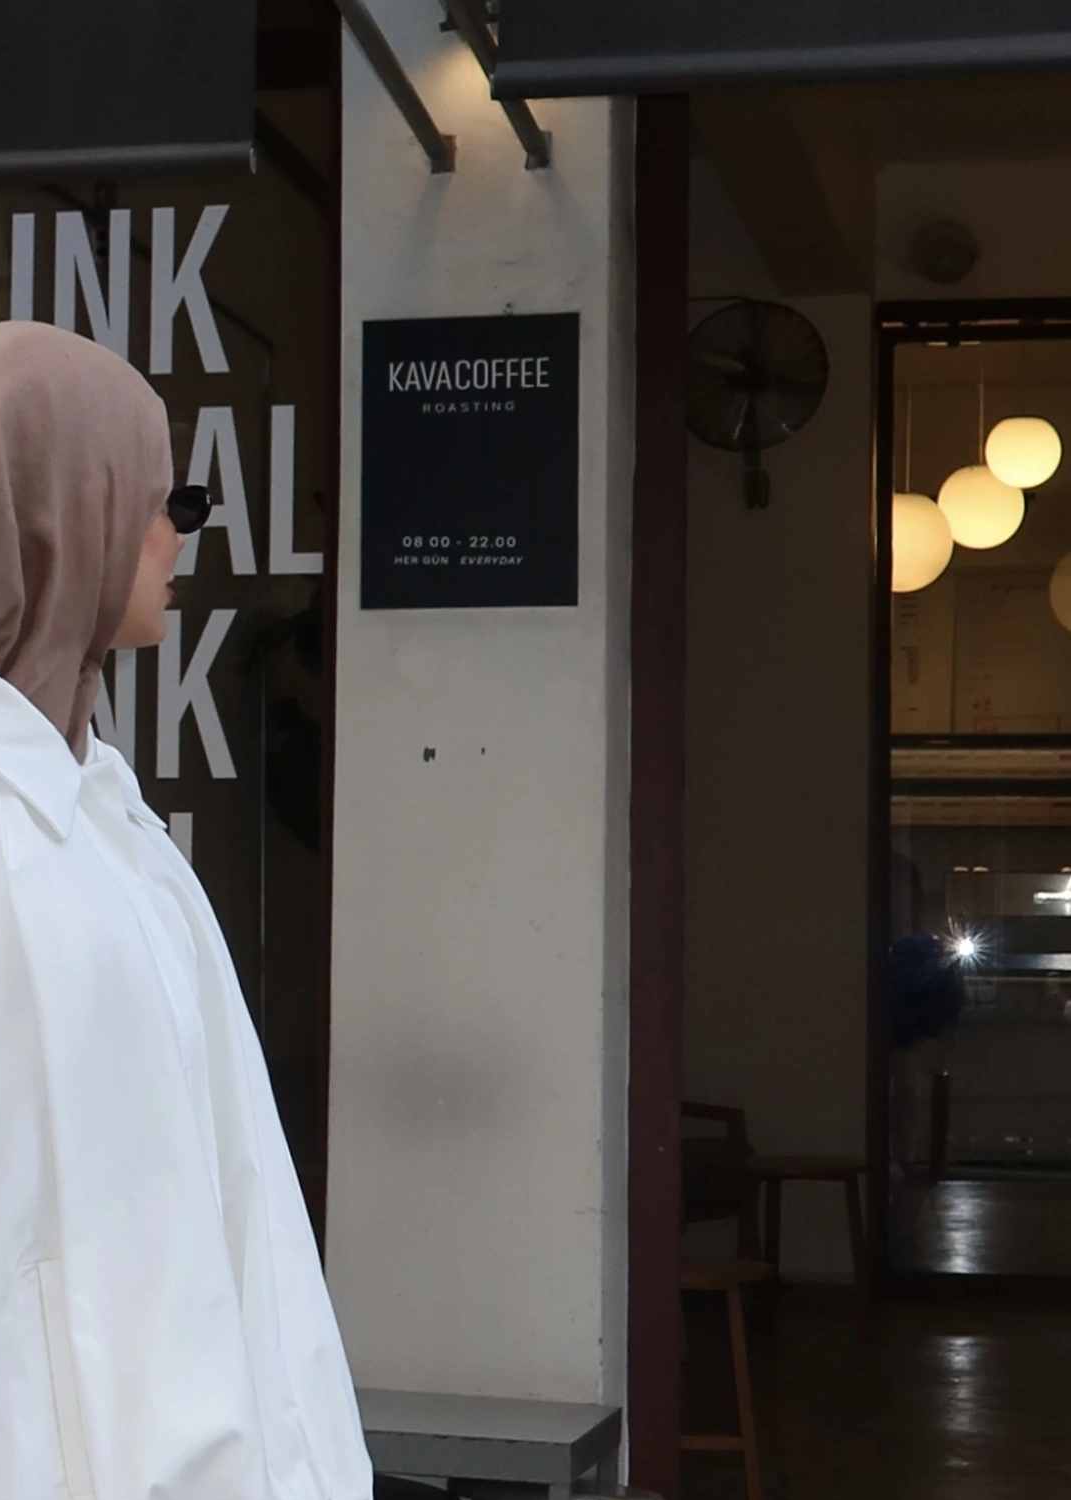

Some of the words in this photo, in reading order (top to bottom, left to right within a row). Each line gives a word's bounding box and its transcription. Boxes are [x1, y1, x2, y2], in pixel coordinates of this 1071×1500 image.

[422, 400, 516, 414] ROASTING
[394, 556, 419, 566] HER
[422, 553, 449, 566] GÜN
[459, 555, 524, 566] EVERYDAY
